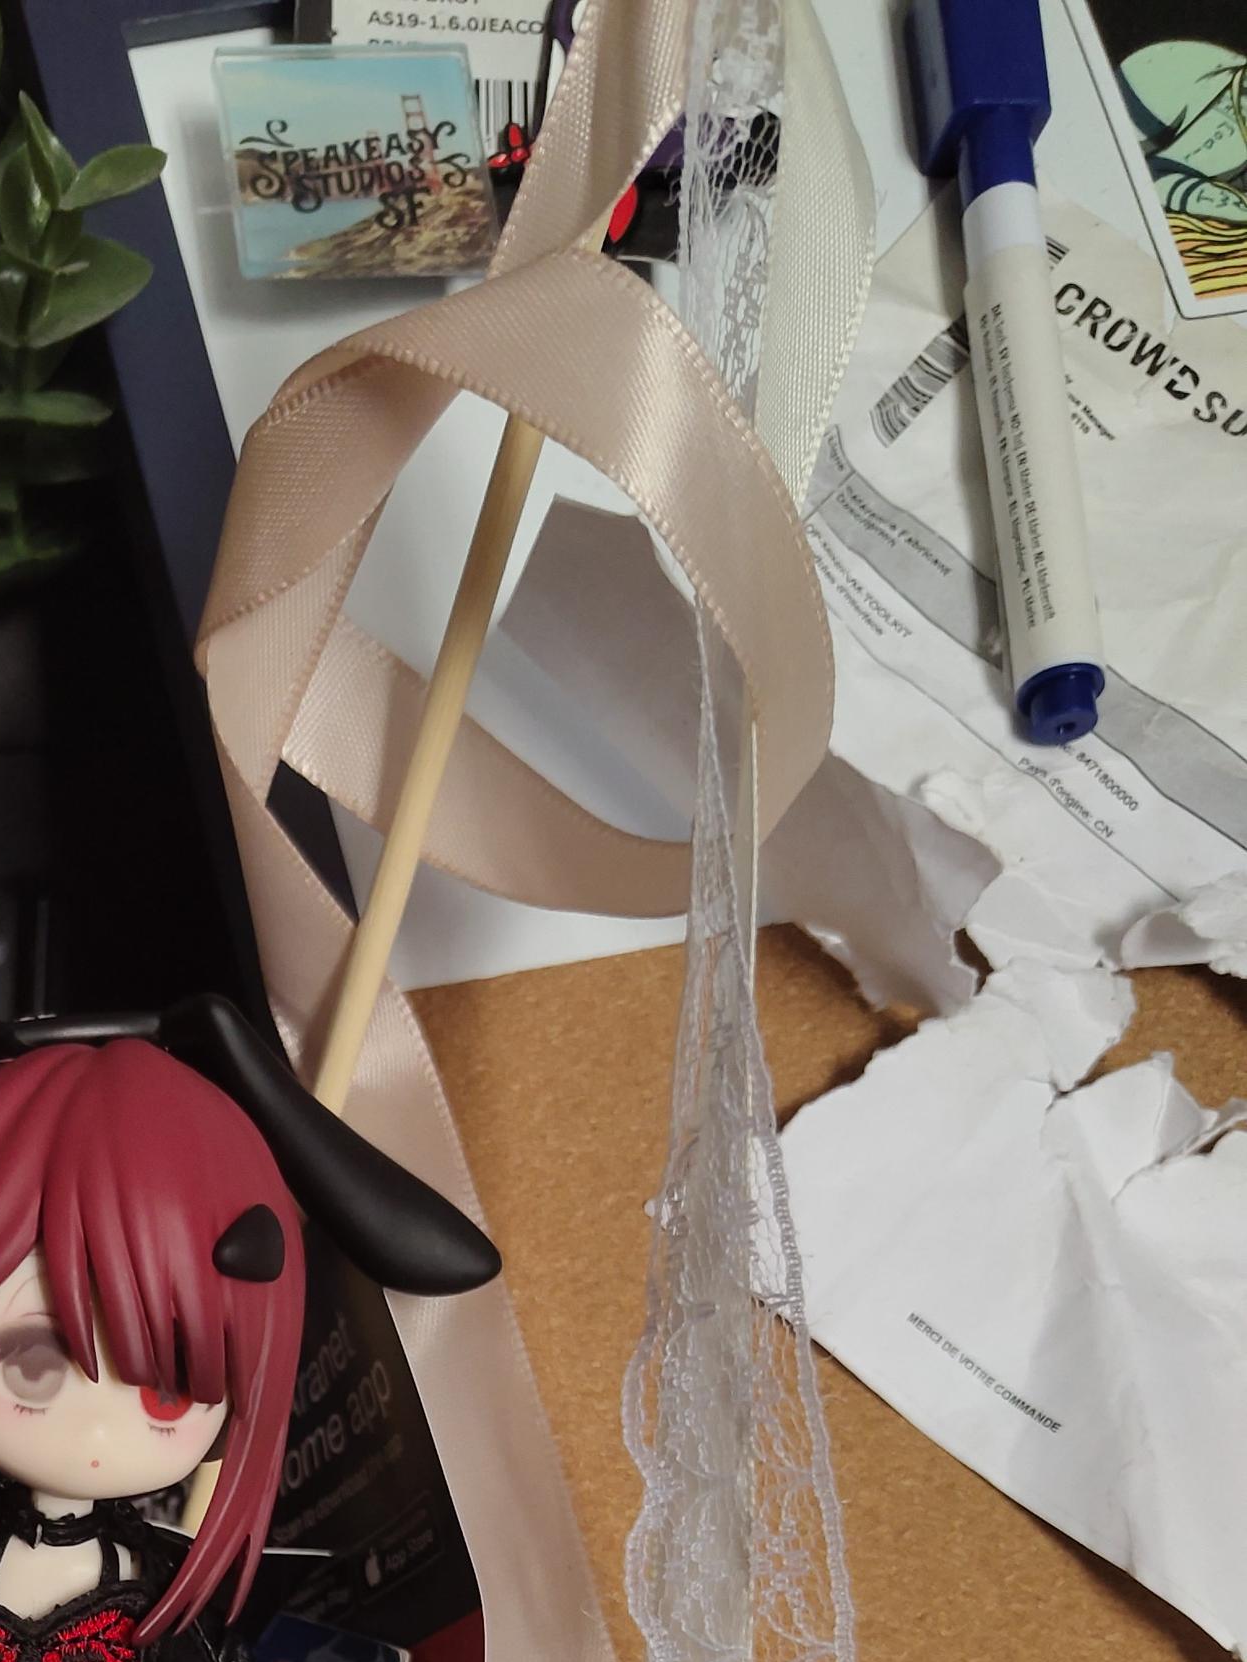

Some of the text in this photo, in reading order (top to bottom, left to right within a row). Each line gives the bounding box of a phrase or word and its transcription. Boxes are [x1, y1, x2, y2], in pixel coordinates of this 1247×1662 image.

[251, 120, 457, 199] SPEAKEASY
[291, 156, 426, 213] STUDIOS
[374, 187, 431, 229] SF
[907, 1312, 944, 1345] MERCI
[958, 1353, 996, 1389] VOTRE
[993, 1384, 1063, 1434] COMMANDE
